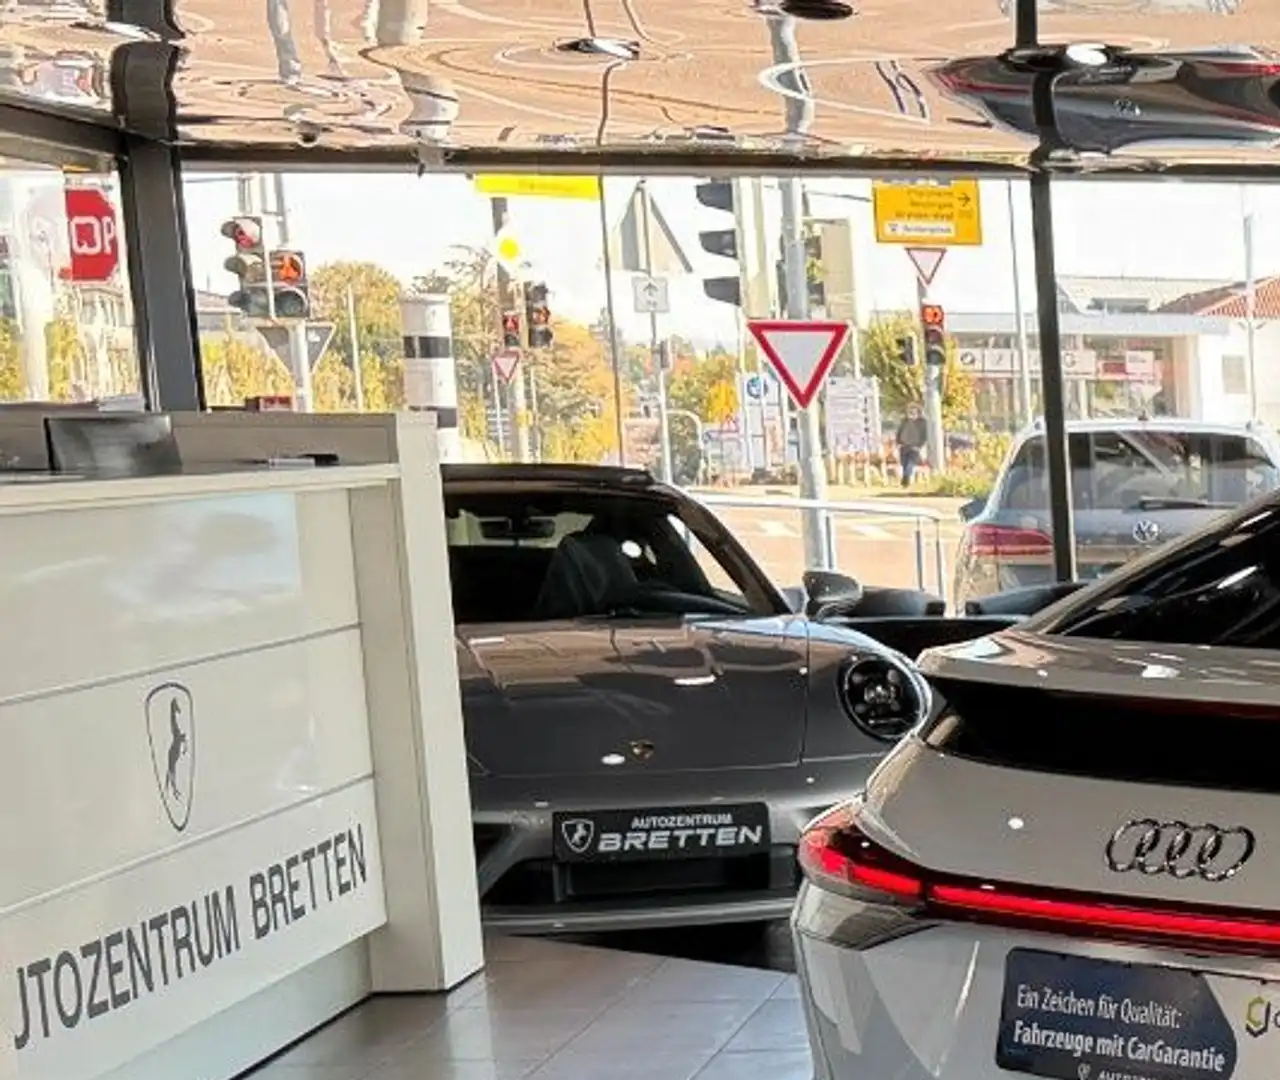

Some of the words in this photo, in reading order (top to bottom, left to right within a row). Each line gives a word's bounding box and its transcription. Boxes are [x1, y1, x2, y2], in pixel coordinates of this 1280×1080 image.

[598, 825, 763, 852] BRETTEN
[631, 813, 734, 829] AUTOZENTRUM
[249, 823, 367, 940] BRETTEN
[1016, 984, 1040, 1009] Ein
[1041, 988, 1095, 1017] Zeichen
[1099, 994, 1121, 1019] für
[1120, 998, 1183, 1029] Qualität:
[1013, 1019, 1094, 1058] Fahrzeuge
[1096, 1034, 1125, 1059] mit
[1127, 1036, 1226, 1072] CarGarantie
